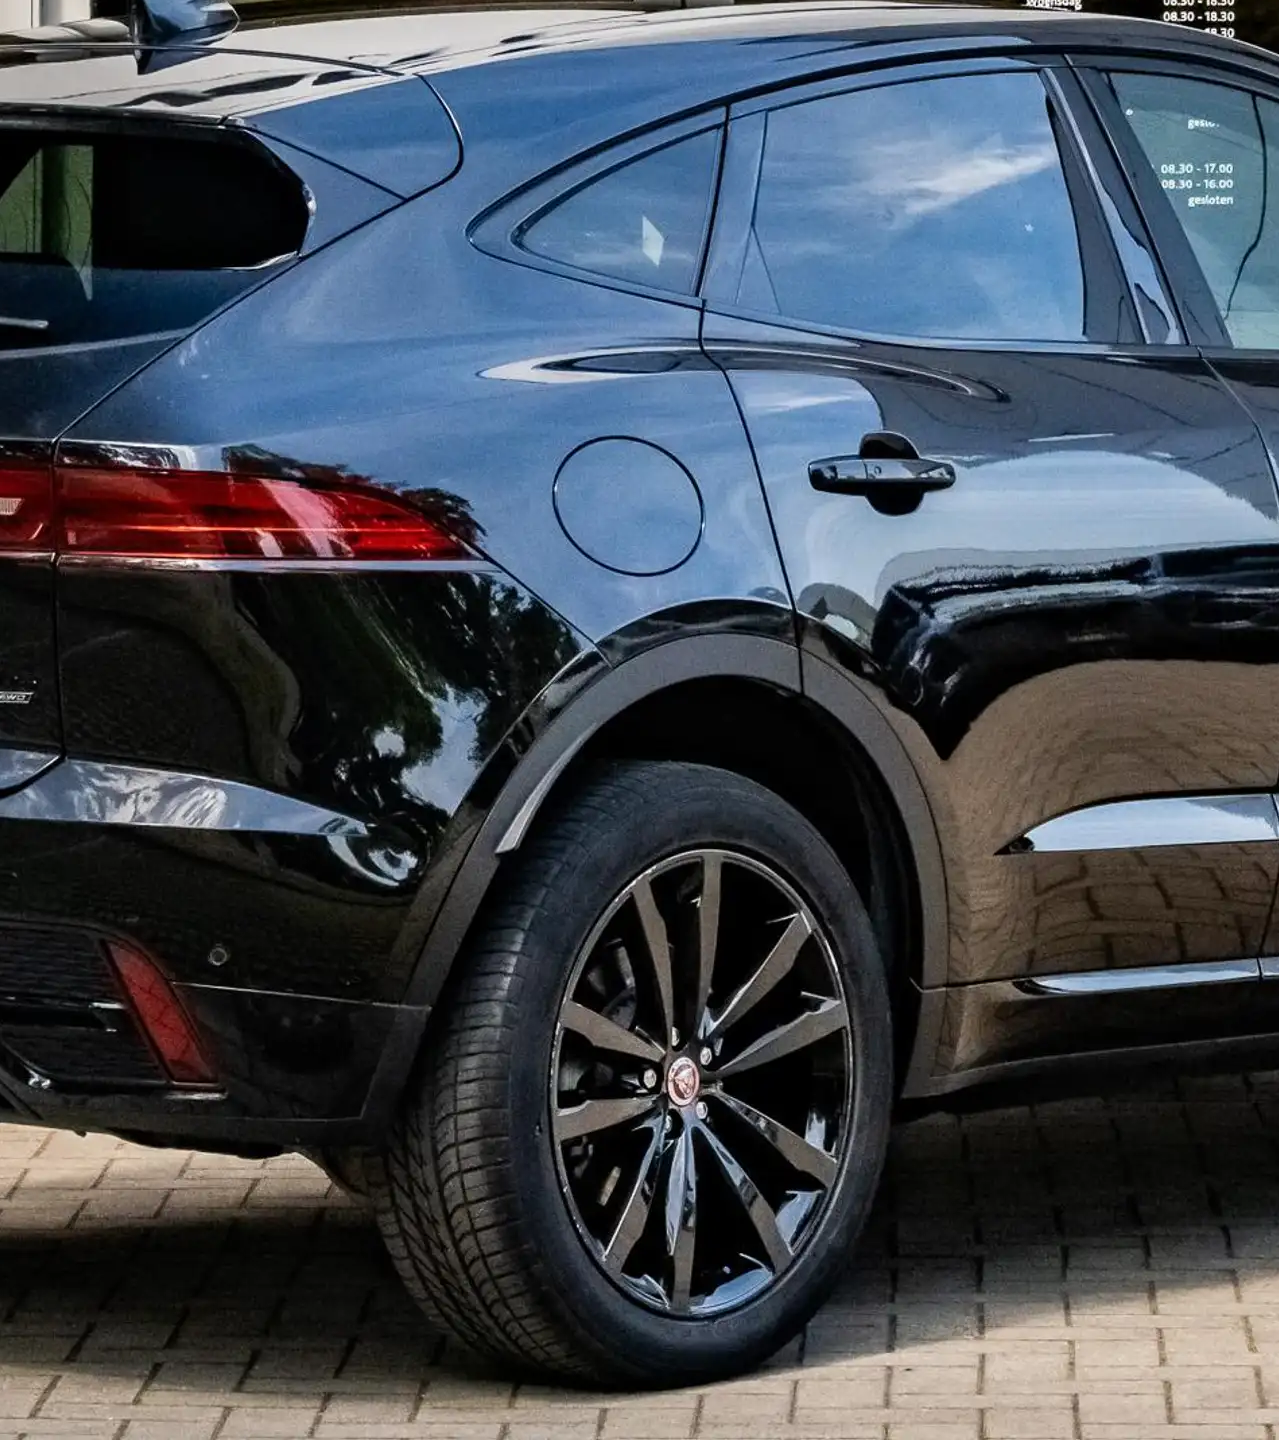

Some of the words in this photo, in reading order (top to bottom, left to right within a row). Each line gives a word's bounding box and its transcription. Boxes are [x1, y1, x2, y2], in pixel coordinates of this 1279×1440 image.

[1163, 12, 1195, 23] 08.30
[1204, 12, 1235, 23] 18.30
[1160, 163, 1194, 174] 08.30
[1204, 163, 1234, 174] 17.00
[1161, 179, 1193, 190] 08.30
[1203, 179, 1234, 190] 16.00
[1187, 194, 1234, 208] gesloten
